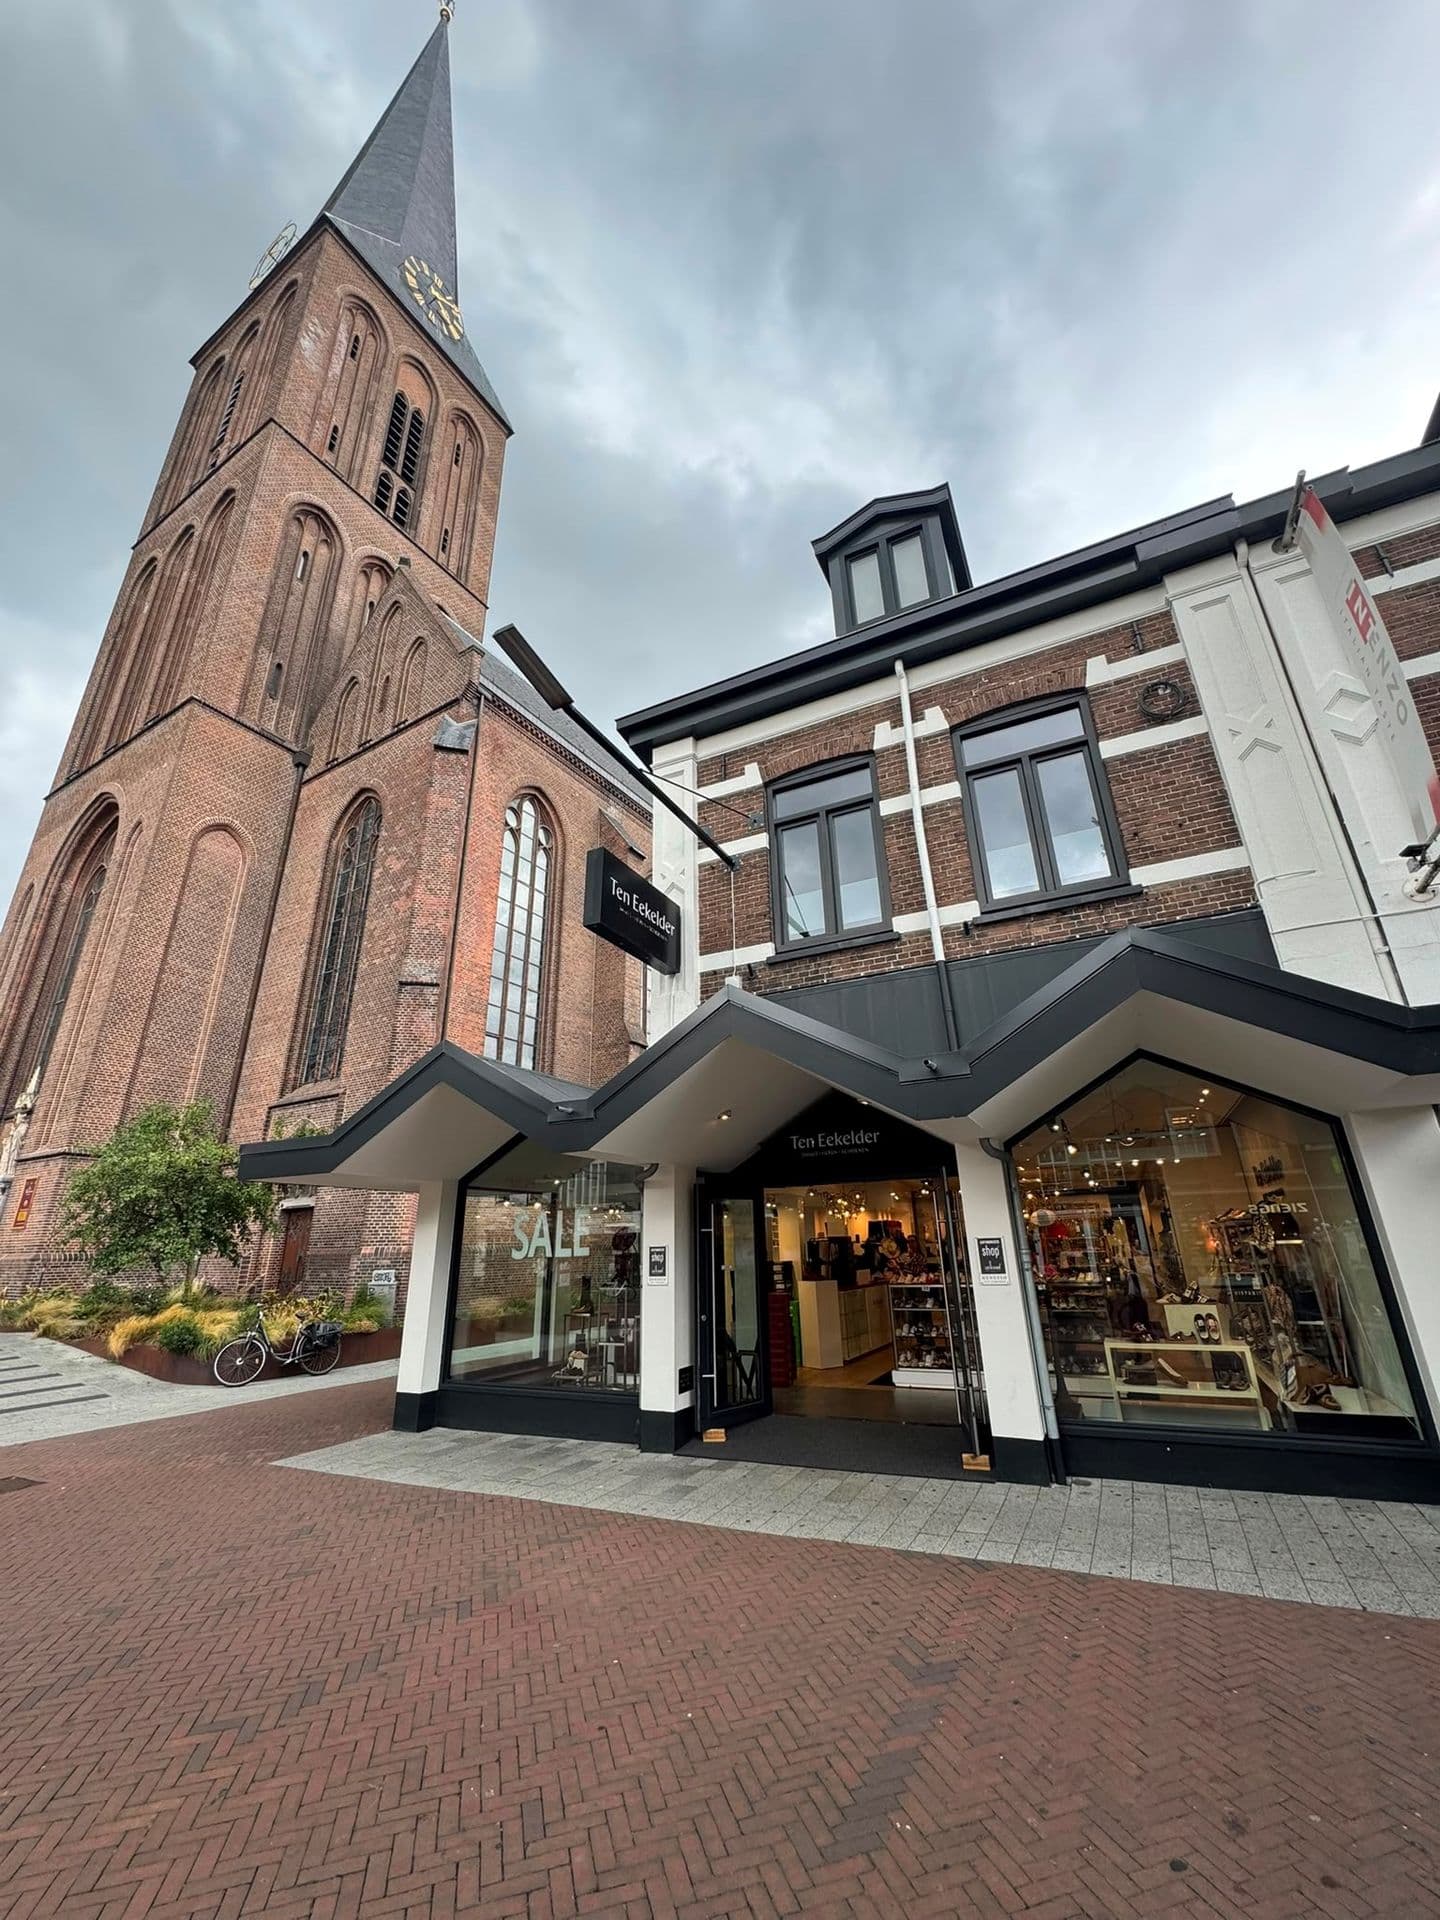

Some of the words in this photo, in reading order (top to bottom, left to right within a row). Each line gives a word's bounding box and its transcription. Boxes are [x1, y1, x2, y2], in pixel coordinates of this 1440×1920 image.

[1345, 577, 1408, 726] INTENZO
[609, 876, 631, 906] Ten
[632, 893, 676, 937] Eekelder
[789, 1135, 815, 1150] Ten
[818, 1129, 881, 1148] Eekelder
[511, 1207, 590, 1260] SALE
[981, 1244, 1000, 1259] shop
